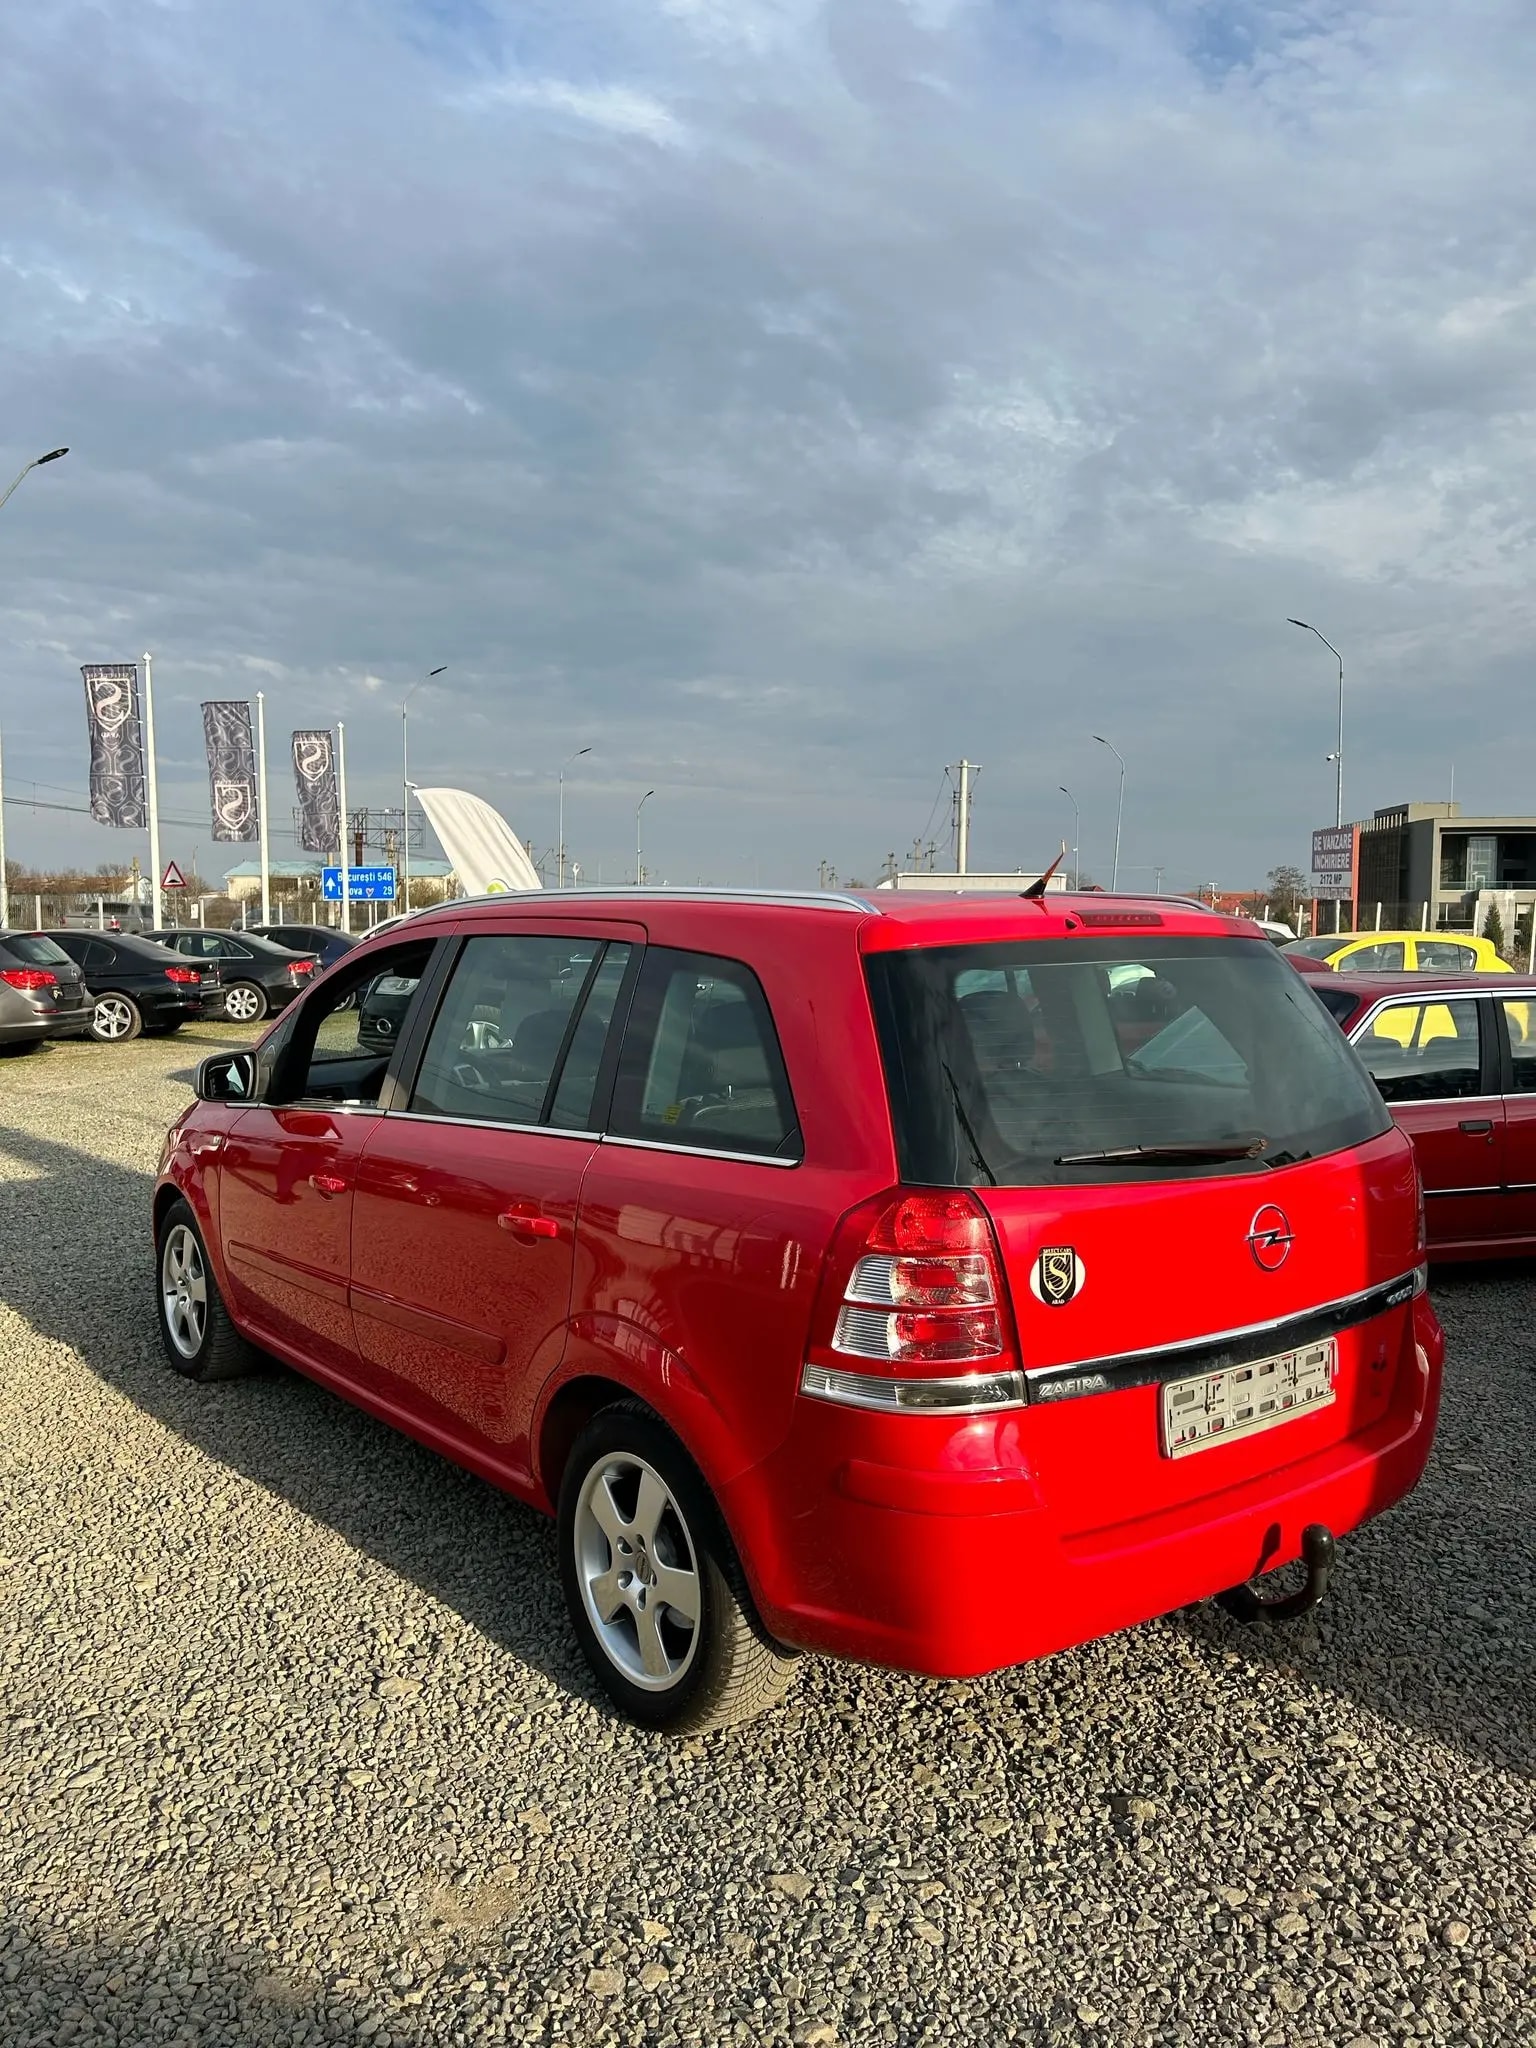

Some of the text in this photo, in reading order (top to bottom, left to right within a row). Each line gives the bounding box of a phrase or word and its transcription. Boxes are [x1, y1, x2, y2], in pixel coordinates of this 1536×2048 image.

[1314, 833, 1351, 850] DE VANZARE
[1315, 853, 1349, 868] INCHIRIERE
[338, 872, 391, 883] Bcurești 546
[1320, 874, 1332, 884] 2172
[338, 886, 392, 895] Lova 29
[1049, 1255, 1067, 1290] S
[1039, 1374, 1106, 1397] ZAFIRA
